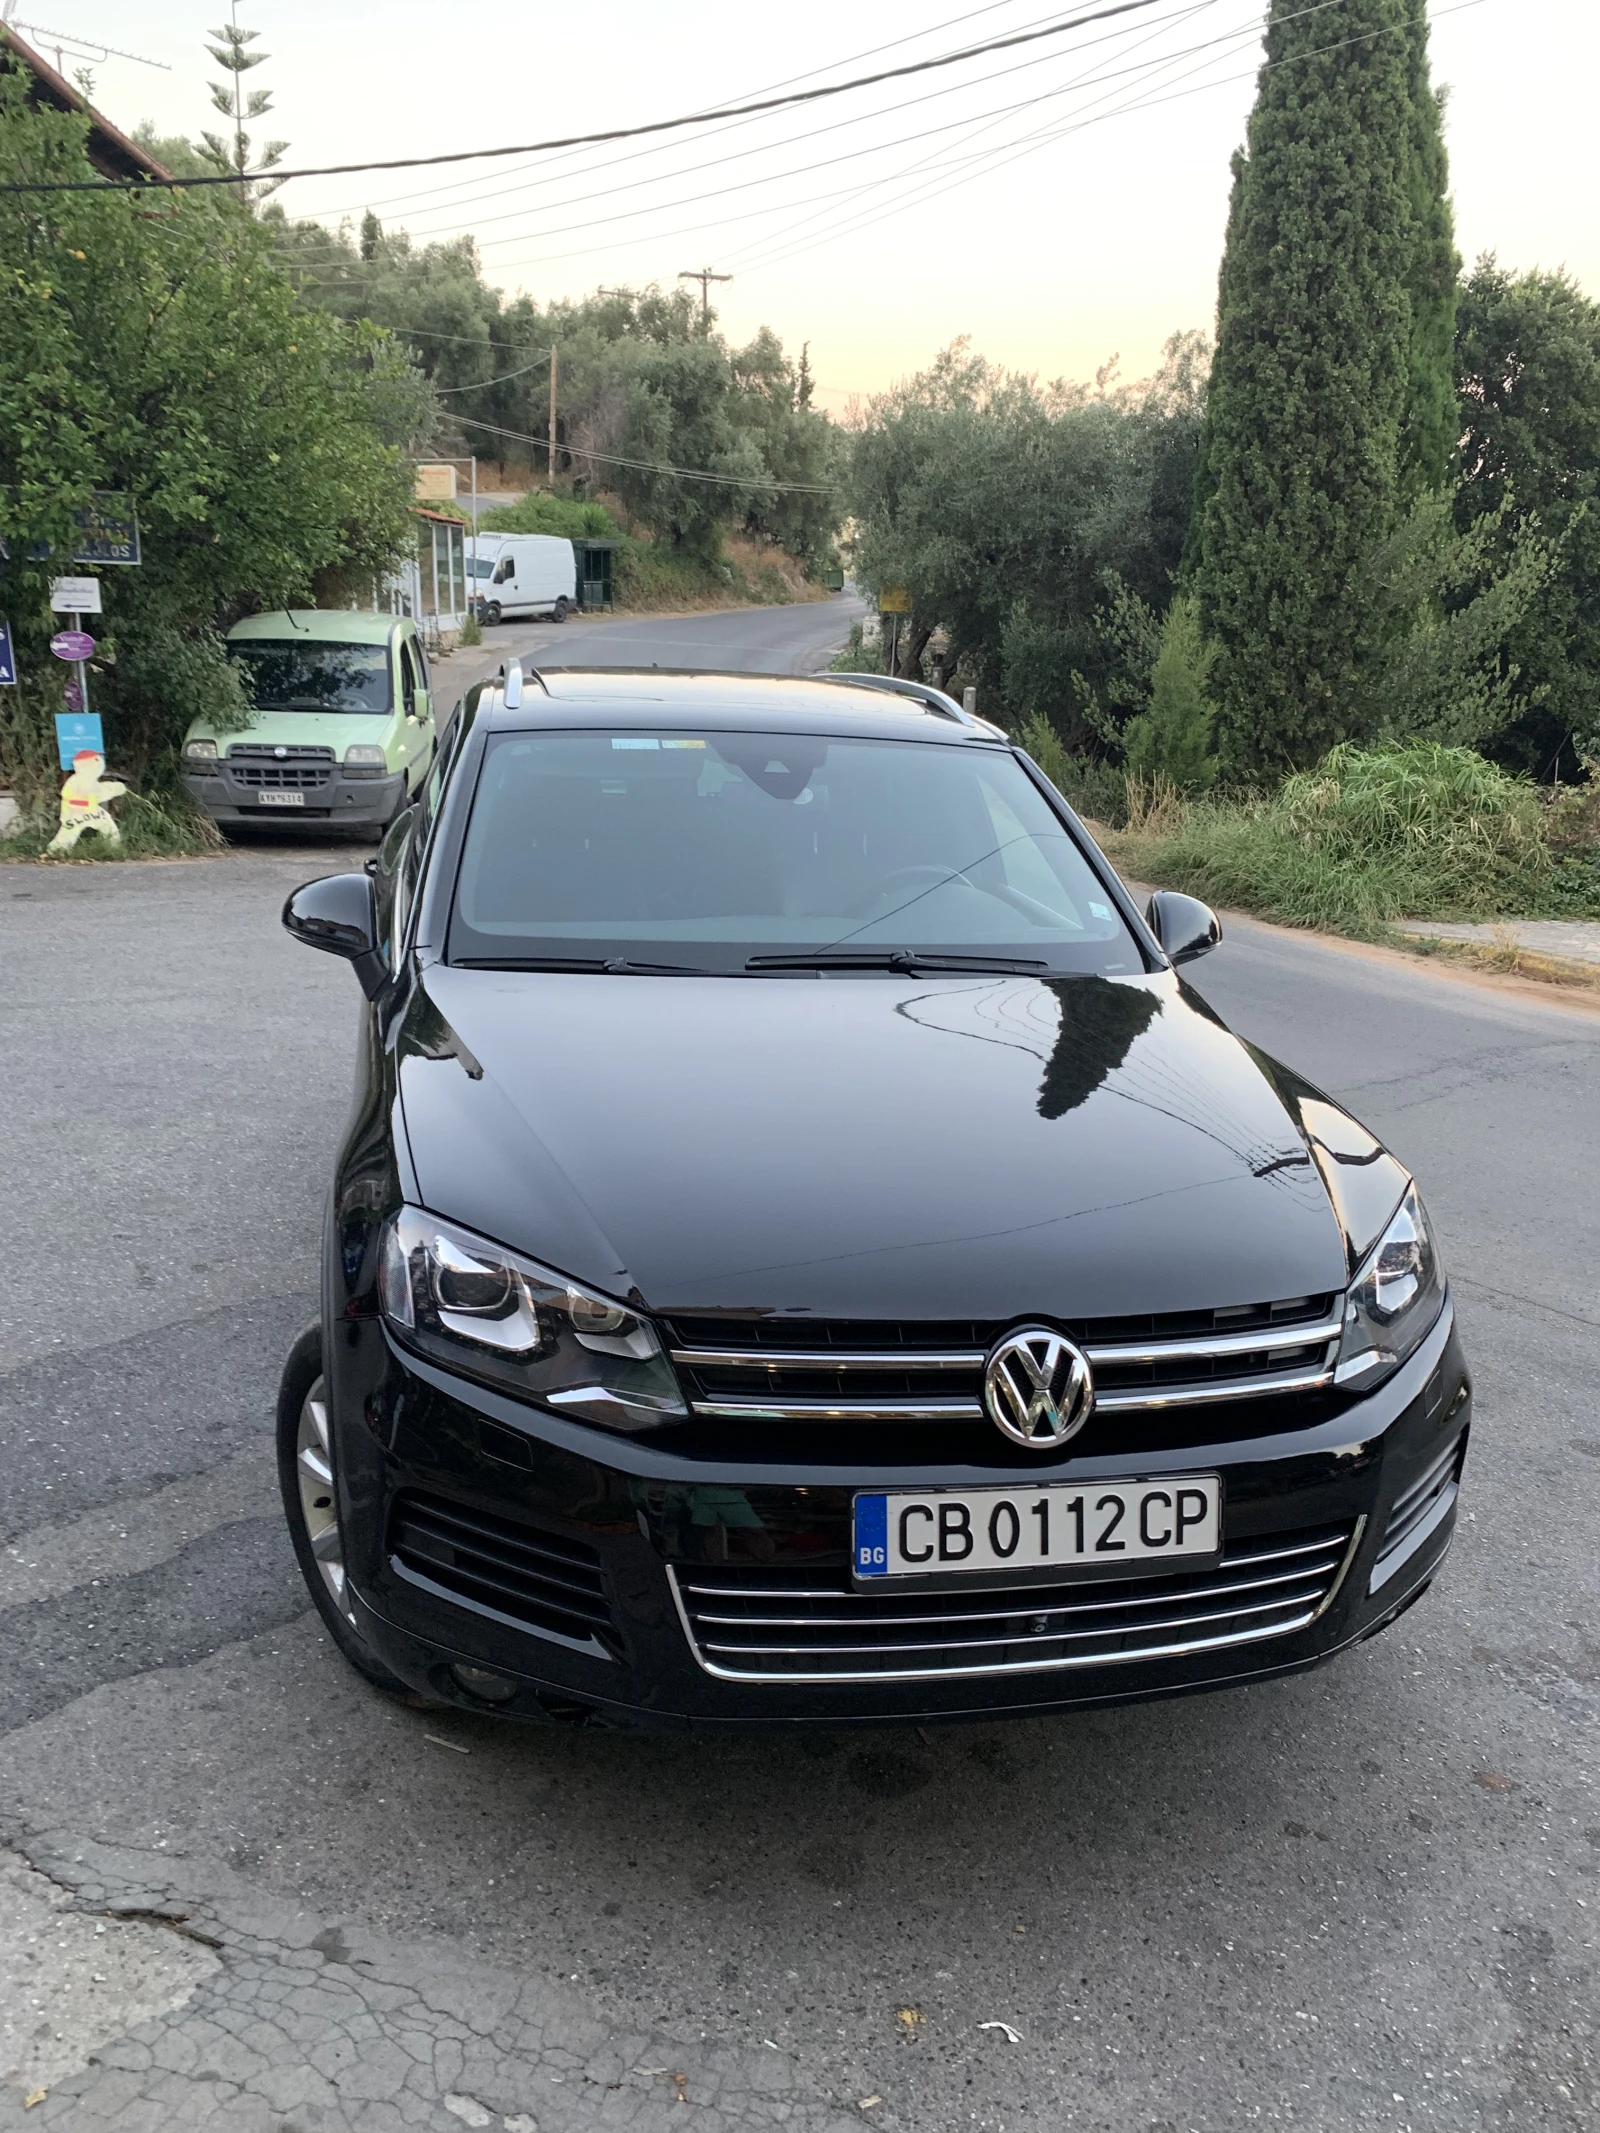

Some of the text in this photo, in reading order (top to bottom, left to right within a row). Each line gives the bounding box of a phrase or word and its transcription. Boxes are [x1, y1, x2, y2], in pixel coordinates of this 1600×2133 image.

[63, 810, 105, 830] SLOW!
[988, 1494, 1126, 1558] 0112
[859, 1547, 885, 1565] BG
